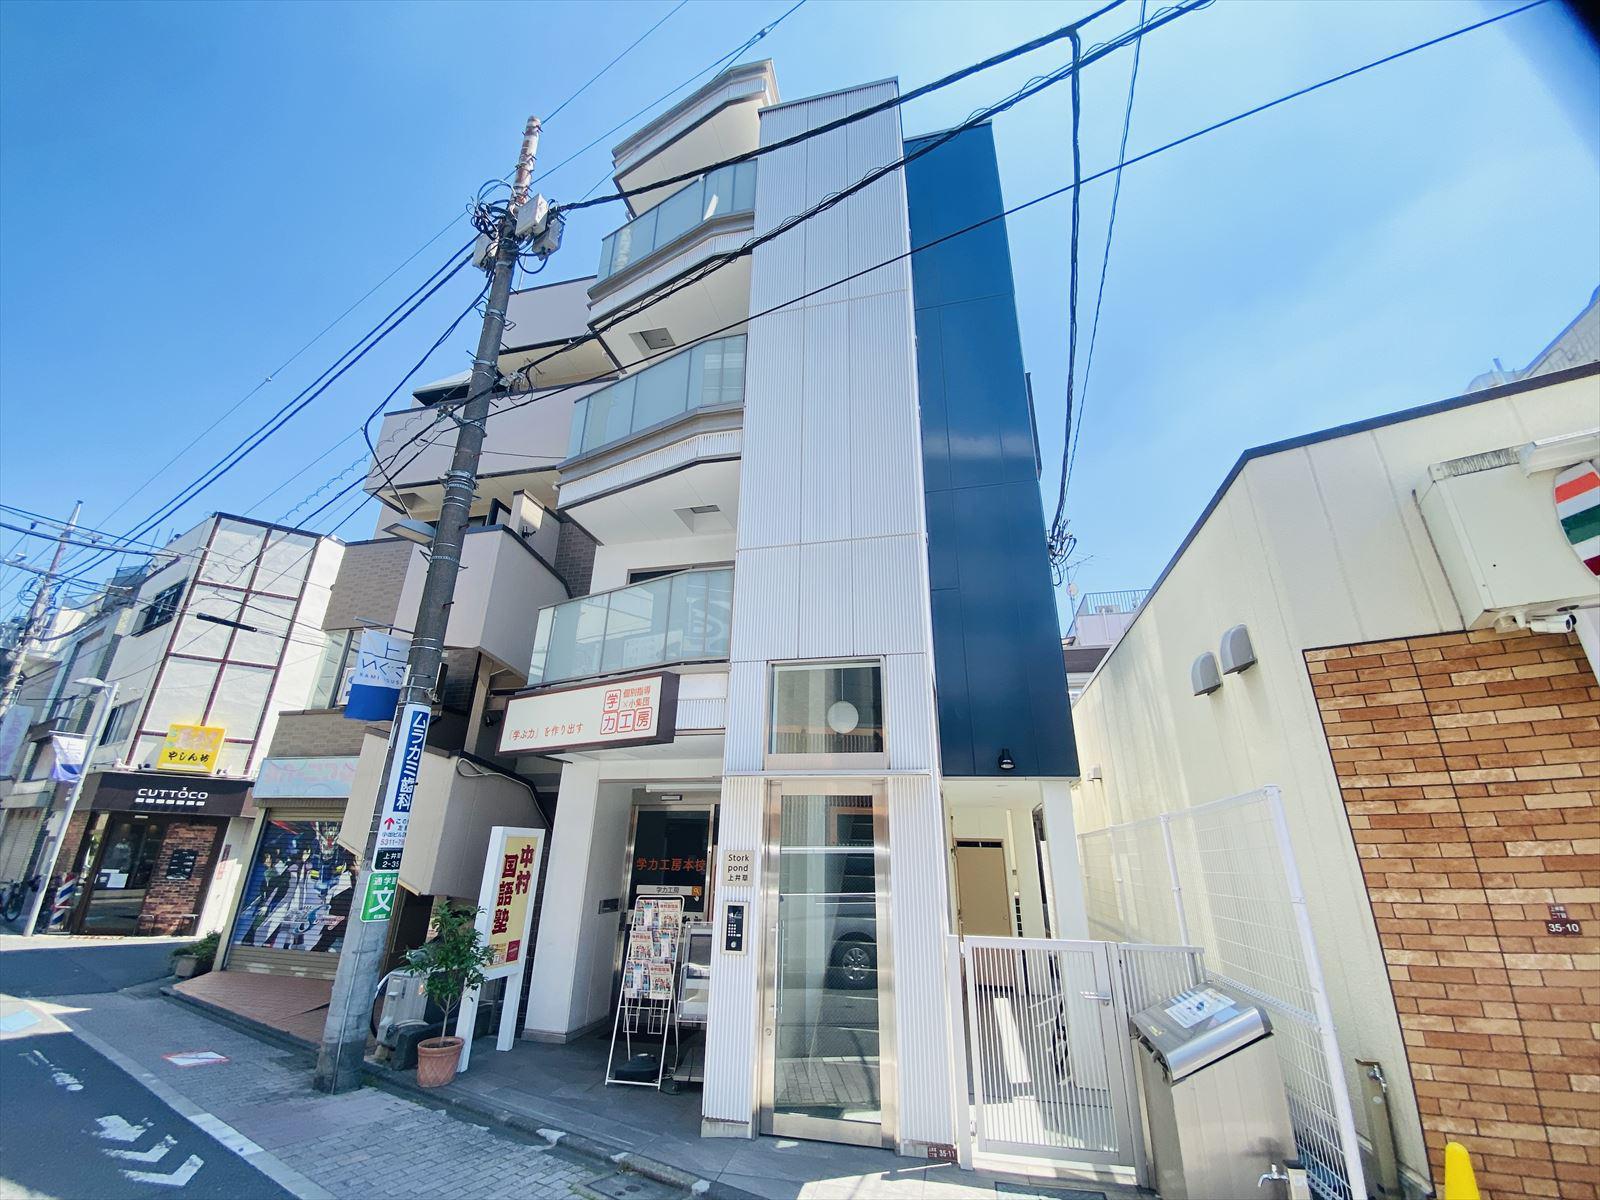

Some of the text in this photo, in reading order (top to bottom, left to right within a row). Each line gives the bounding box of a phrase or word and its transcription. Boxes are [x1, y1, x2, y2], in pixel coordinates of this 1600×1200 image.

[396, 713, 426, 811] ムラカミ歯科
[137, 787, 208, 800] CUTTOCO
[728, 854, 749, 862] Stork
[515, 844, 535, 895] 中村
[728, 865, 748, 873] pond
[368, 886, 394, 913] 文
[492, 853, 519, 935] 国語塾
[1548, 923, 1579, 933] 35-10
